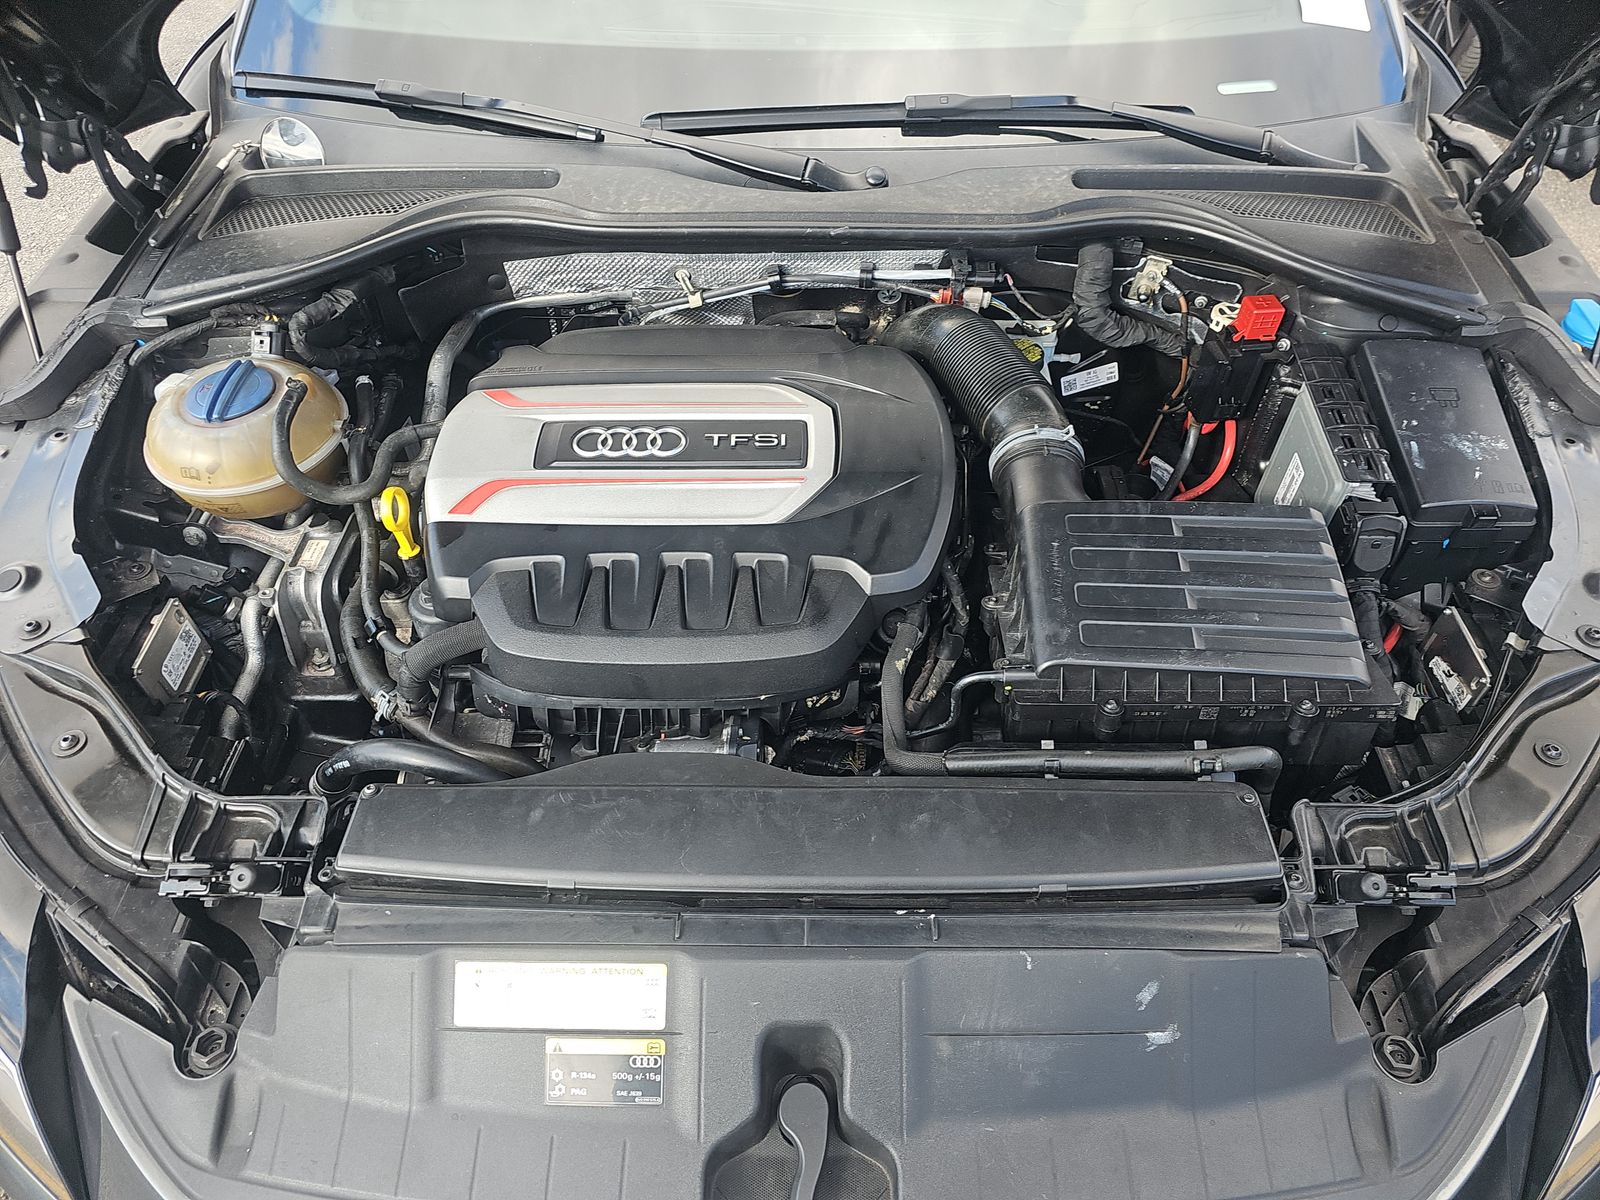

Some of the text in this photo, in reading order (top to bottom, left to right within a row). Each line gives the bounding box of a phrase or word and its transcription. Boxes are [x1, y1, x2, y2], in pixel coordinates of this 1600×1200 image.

[704, 433, 787, 448] TFSI
[591, 968, 644, 976] ATTENTION
[612, 1072, 633, 1081] 500g
[570, 1088, 588, 1096] PAG
